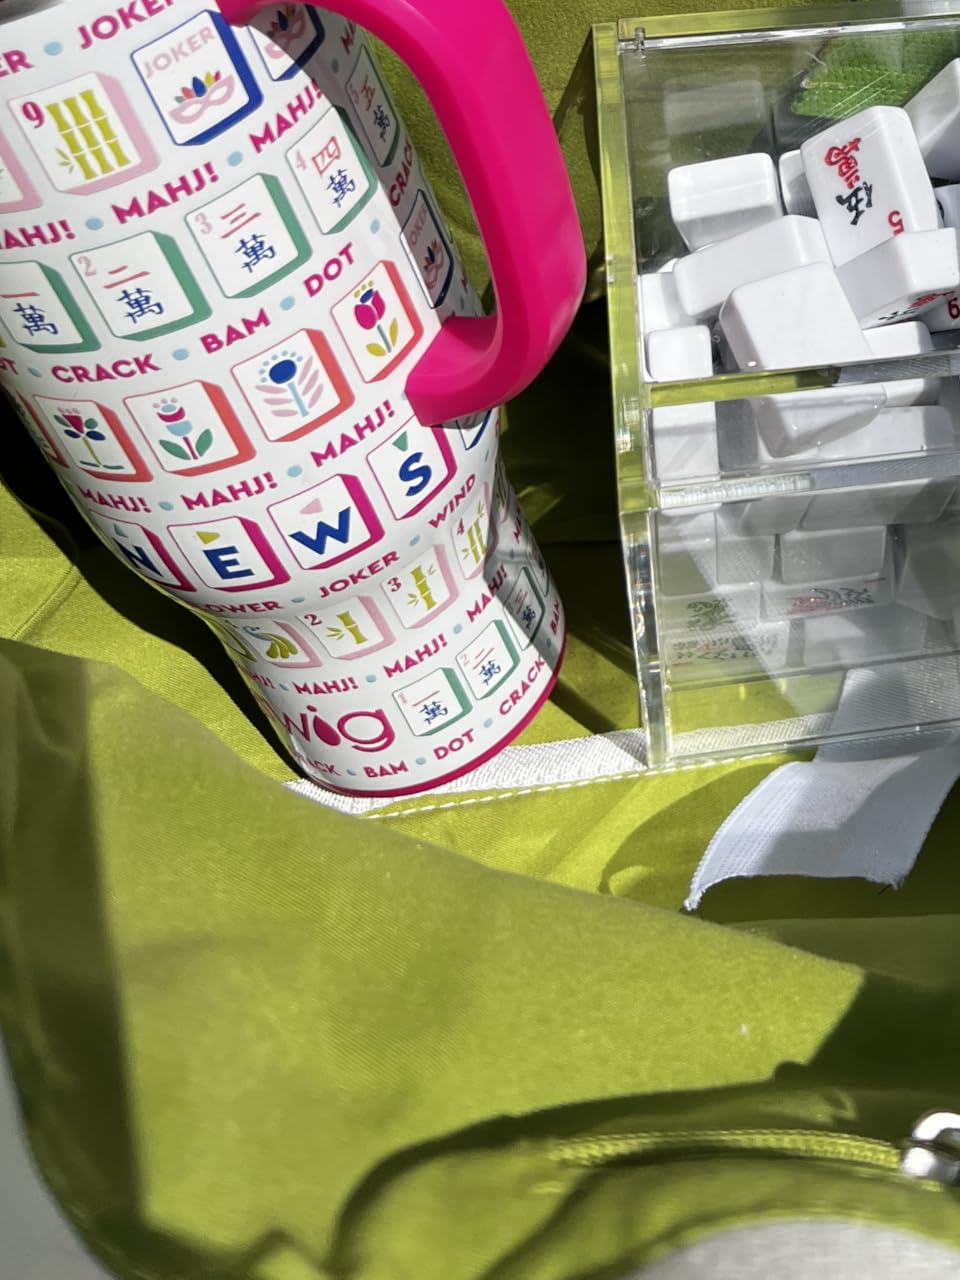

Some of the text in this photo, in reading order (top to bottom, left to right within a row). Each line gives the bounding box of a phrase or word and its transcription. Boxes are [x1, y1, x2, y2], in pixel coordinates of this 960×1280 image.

[144, 26, 216, 78] JOKER
[0, 80, 324, 250] AHJ! MAHJ! MAHJ!
[22, 101, 45, 128] 9
[78, 256, 96, 276] 2
[194, 212, 213, 235] 3
[51, 354, 161, 383] CRACK
[200, 308, 271, 354] BAM
[303, 242, 354, 297] DOT
[181, 471, 278, 510] MAHJ!
[310, 399, 396, 468] MAHJ!
[203, 546, 255, 580] E
[288, 506, 351, 555] W
[398, 451, 432, 497] S
[204, 600, 281, 613] OWER
[319, 551, 401, 598] JOKER
[428, 473, 476, 529] WIND
[292, 676, 359, 695] MAHJ!
[383, 633, 448, 678] MAHJ!
[466, 565, 508, 623] MAHJ!
[304, 613, 322, 626] 2
[387, 576, 402, 592] 3
[363, 760, 408, 778] BAM
[433, 728, 474, 760] DOT
[499, 654, 545, 715] CRACK
